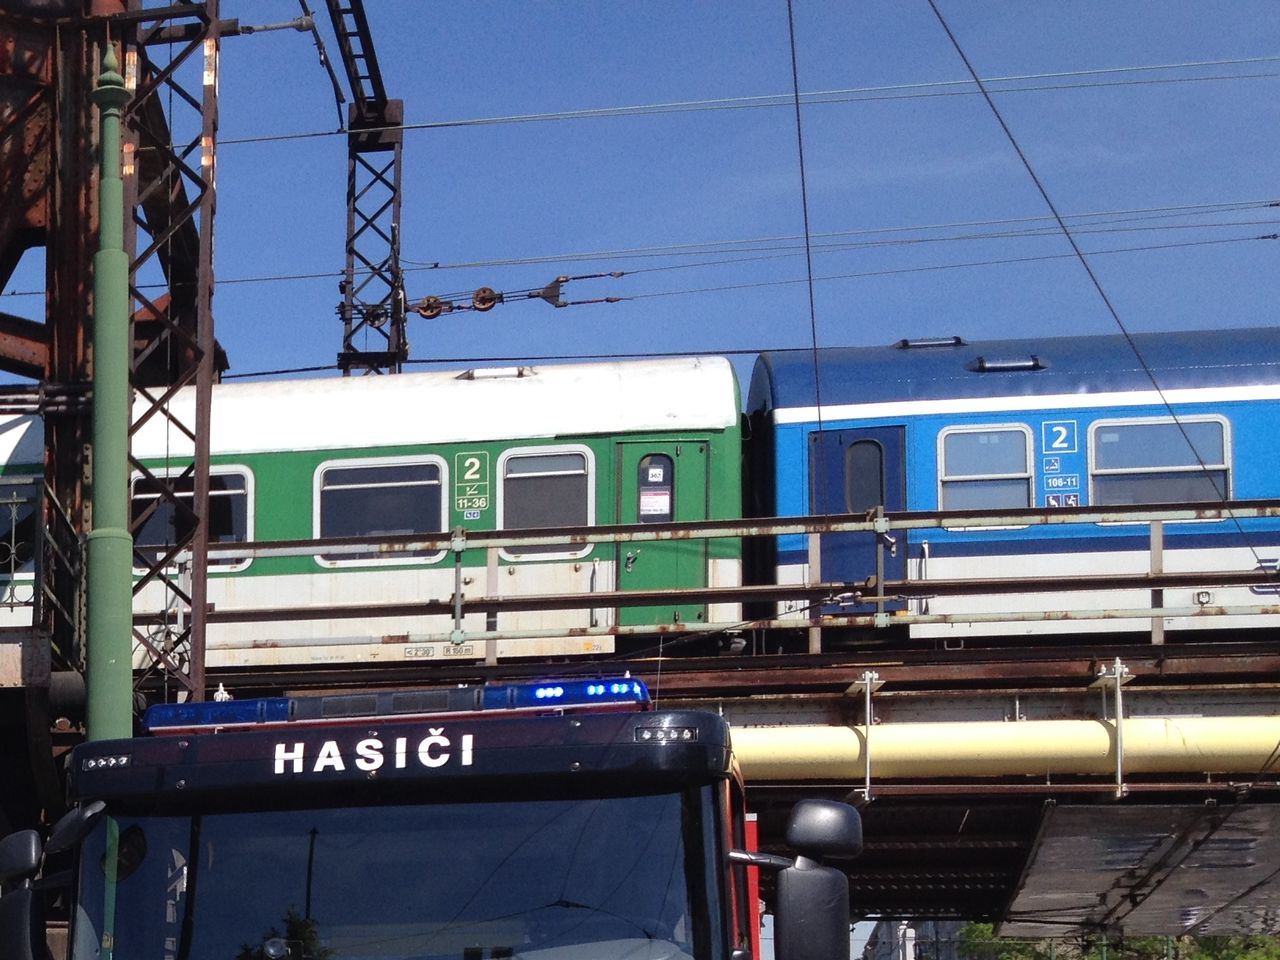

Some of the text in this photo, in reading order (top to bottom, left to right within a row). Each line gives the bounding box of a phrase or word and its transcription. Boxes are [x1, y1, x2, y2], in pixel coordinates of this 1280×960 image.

[1052, 426, 1069, 448] 2
[464, 457, 480, 480] 2
[457, 497, 487, 509] 11-36
